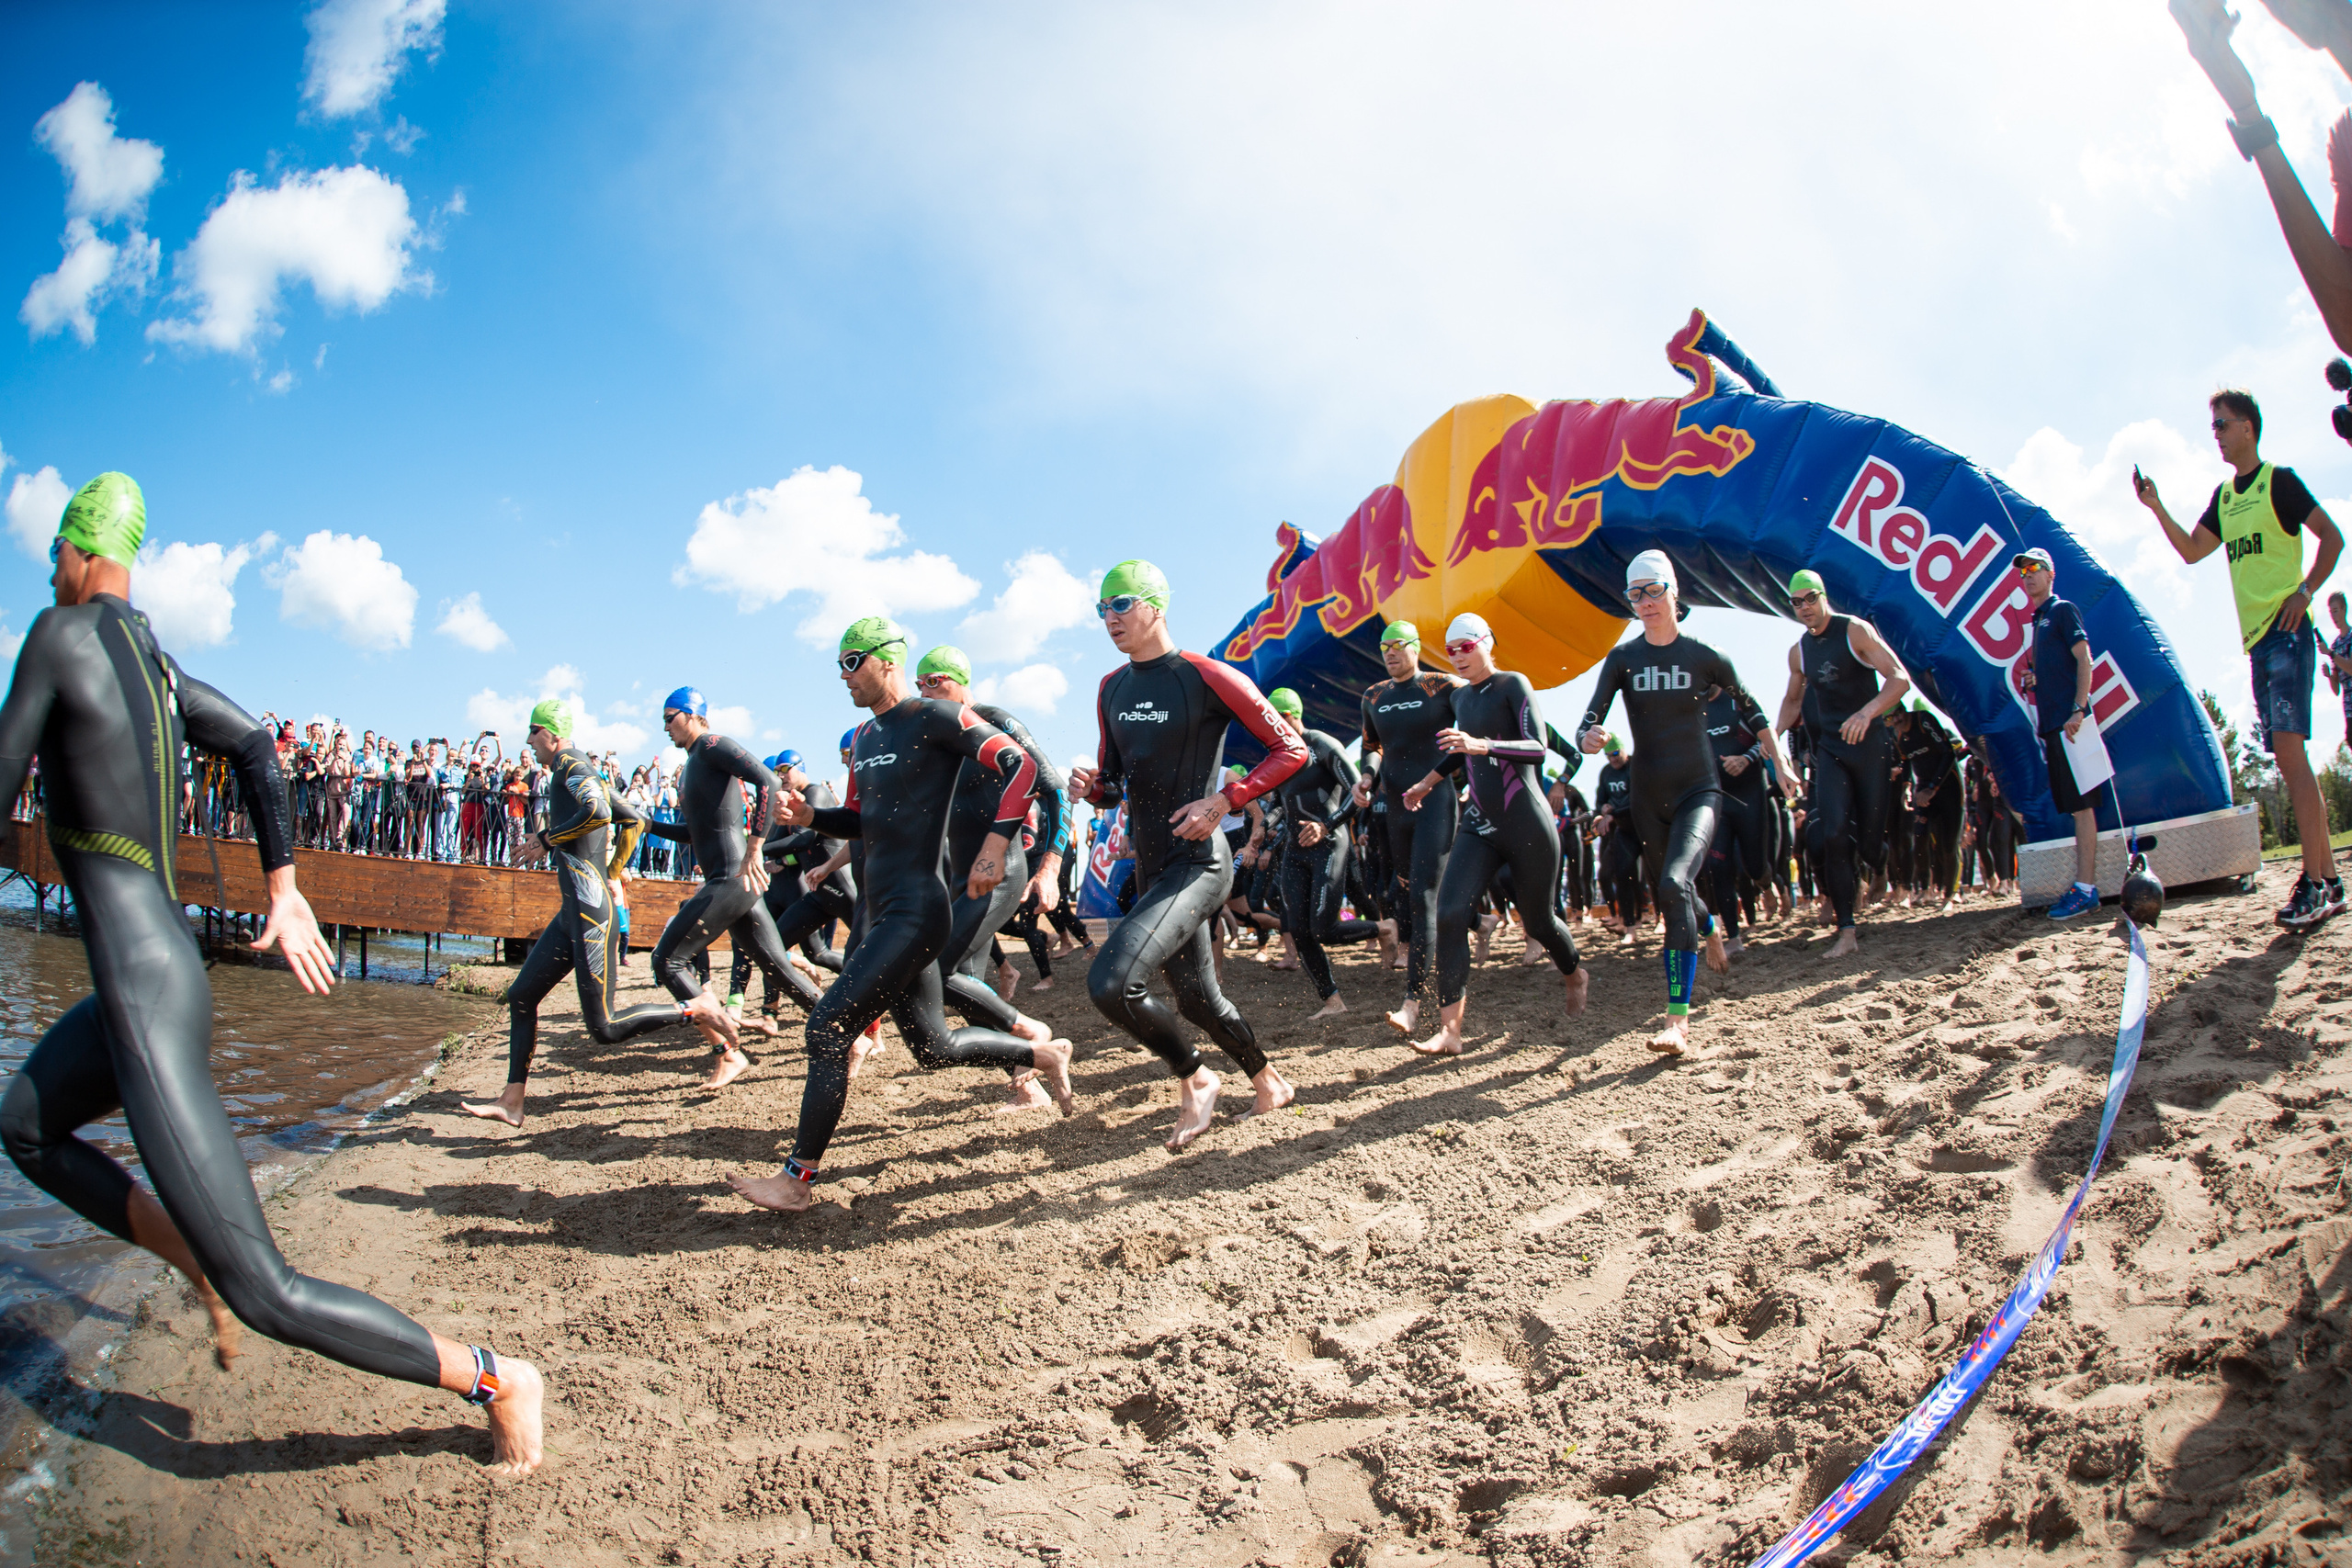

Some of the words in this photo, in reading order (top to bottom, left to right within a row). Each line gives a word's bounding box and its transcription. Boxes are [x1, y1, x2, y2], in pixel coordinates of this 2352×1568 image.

[1830, 457, 2004, 614] Red
[1633, 665, 1691, 692] dhb
[1378, 700, 1423, 714] orca
[1118, 710, 1169, 724] nabaiji
[854, 752, 898, 773] orca
[1609, 781, 1627, 792] TYR
[755, 784, 770, 832] attack
[1203, 807, 1220, 823] 19
[1373, 801, 1388, 813] dh
